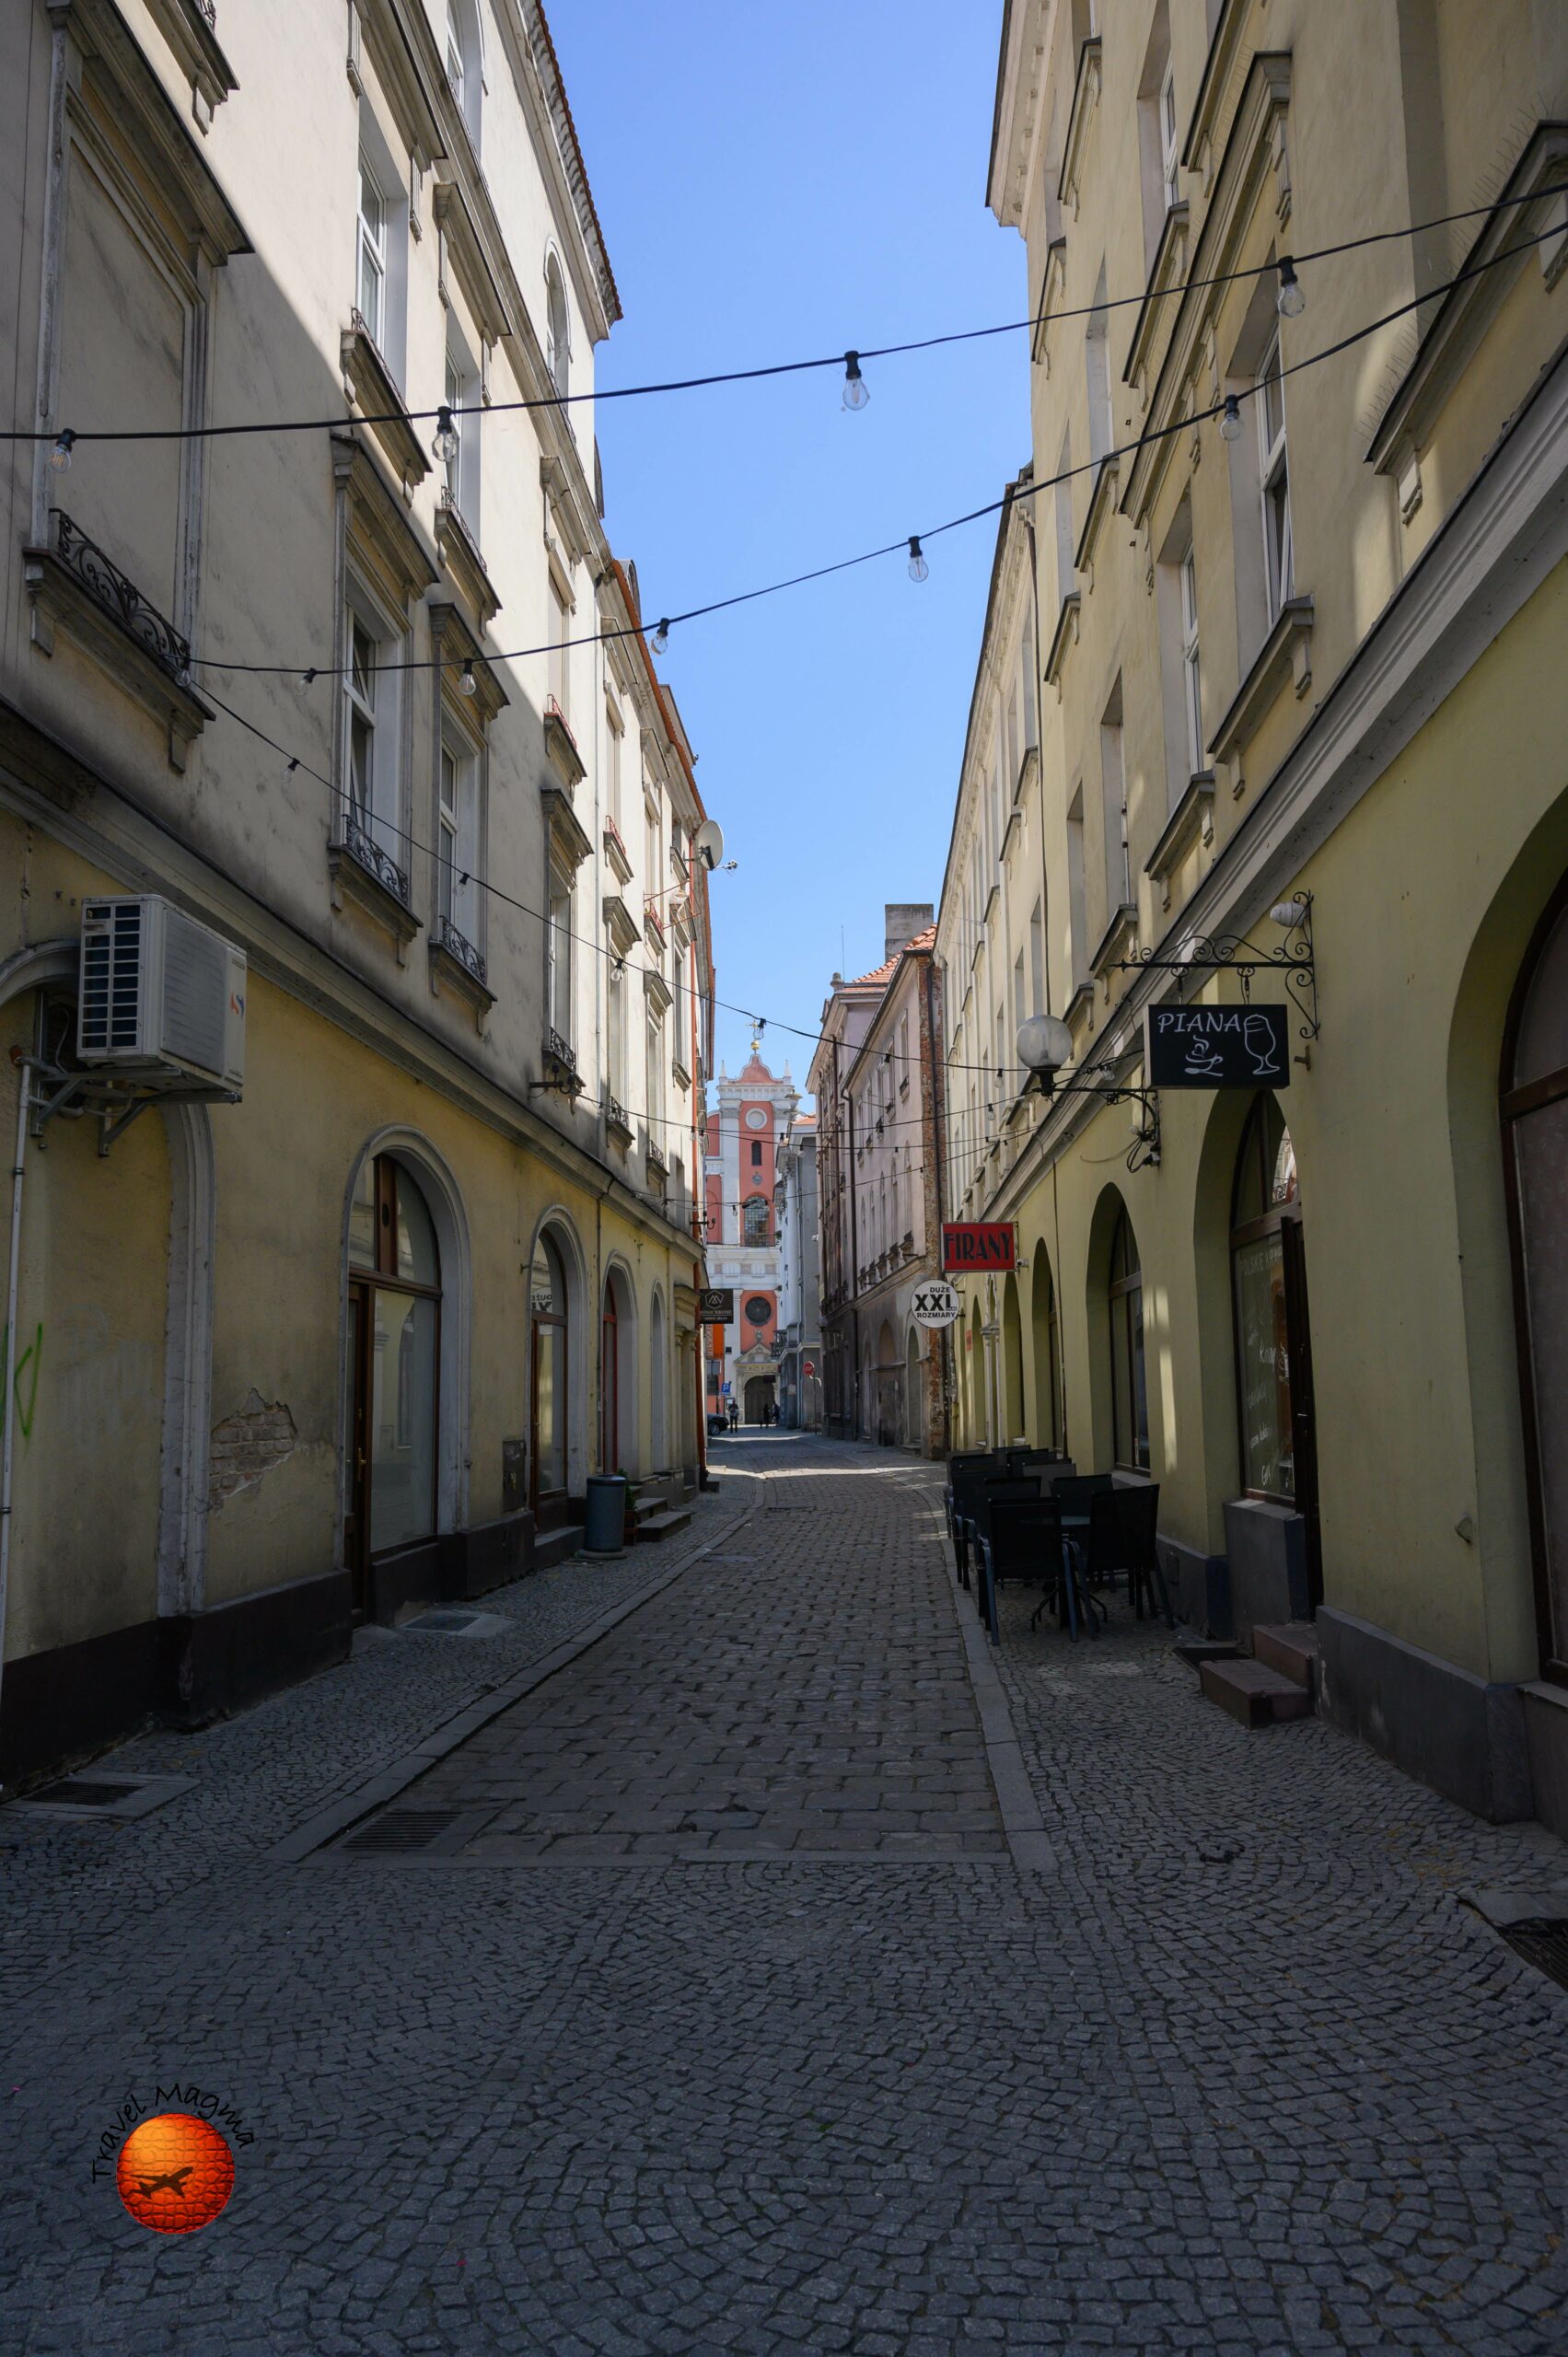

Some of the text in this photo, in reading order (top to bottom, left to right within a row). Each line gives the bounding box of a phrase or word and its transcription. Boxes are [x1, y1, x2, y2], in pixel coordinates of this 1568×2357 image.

[1157, 1012, 1242, 1034] PIANA
[944, 1232, 1011, 1260] FIRANY
[914, 1295, 958, 1311] XXL
